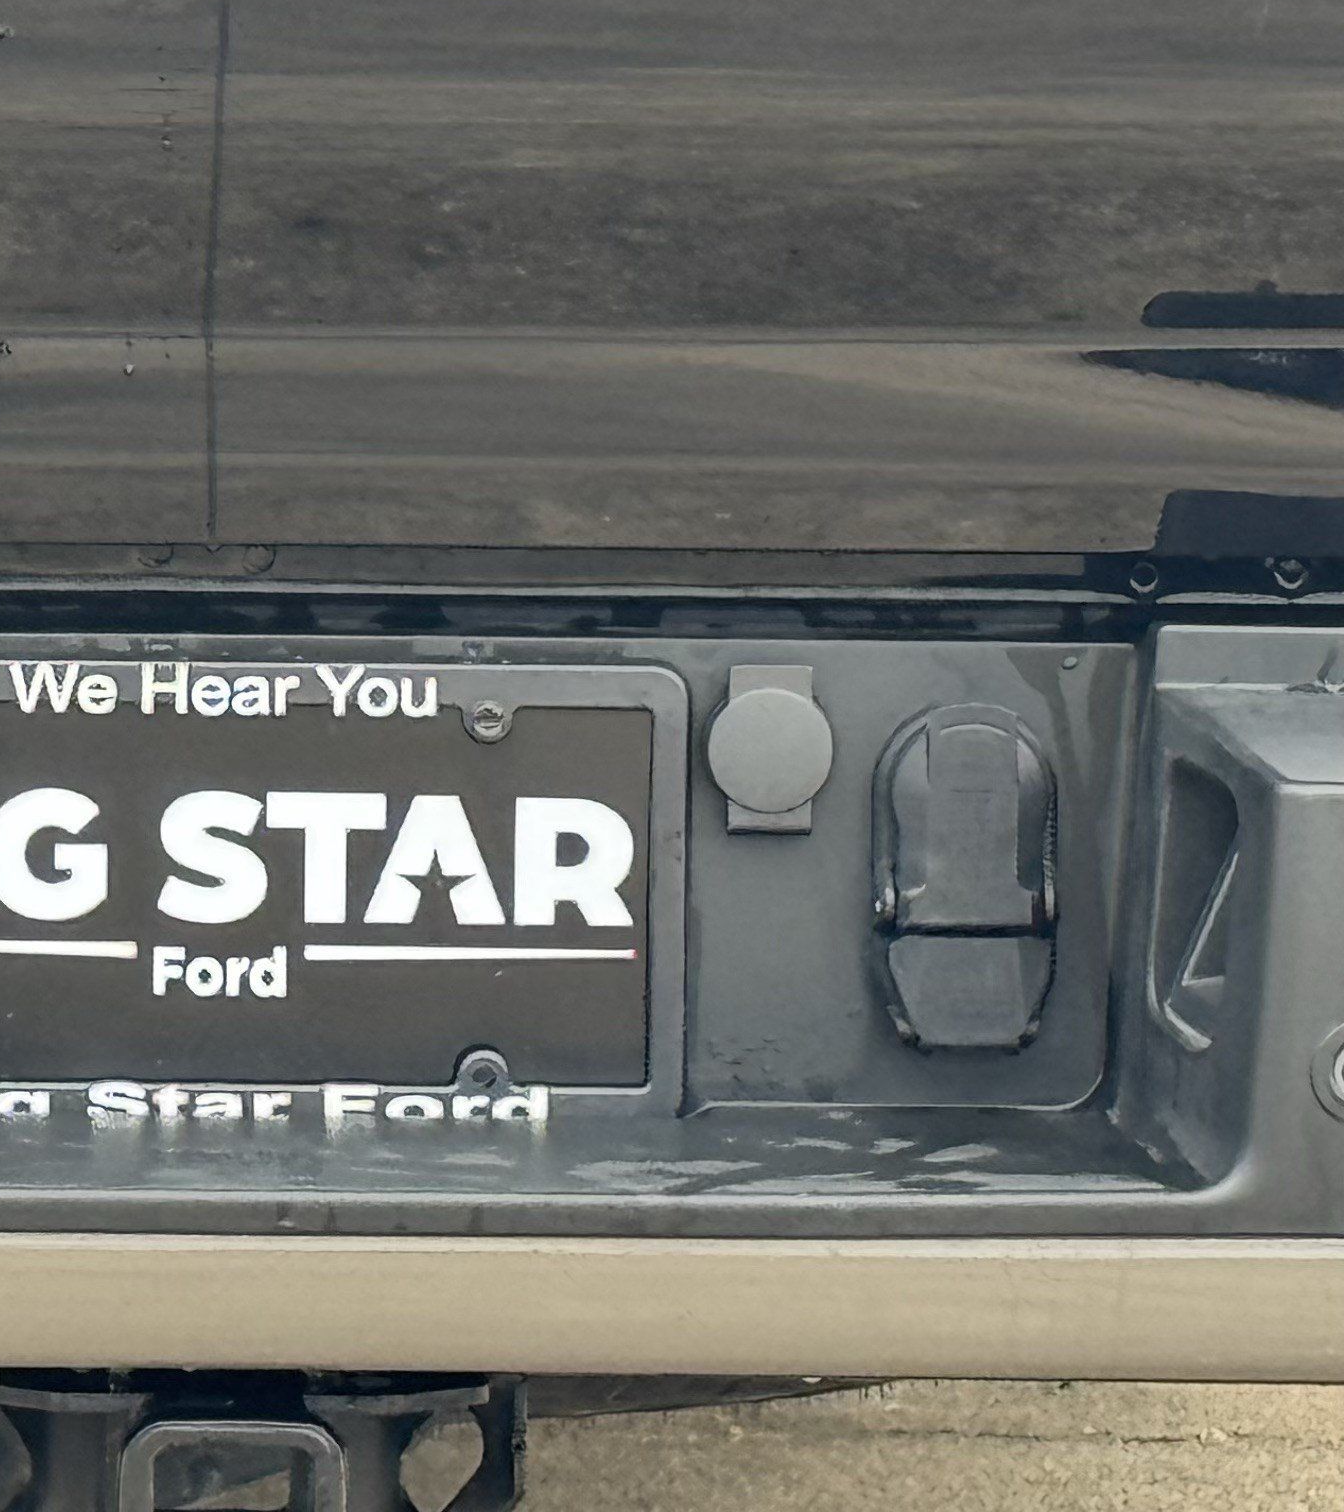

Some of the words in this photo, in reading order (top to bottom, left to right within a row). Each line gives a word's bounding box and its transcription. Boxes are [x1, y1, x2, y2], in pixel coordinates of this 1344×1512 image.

[8, 661, 118, 714] We
[140, 662, 300, 717] Hear
[315, 663, 438, 717] You
[156, 789, 634, 927] STAR
[151, 945, 289, 1000] Ford
[86, 1080, 292, 1119] Star
[323, 1082, 550, 1121] Ford
